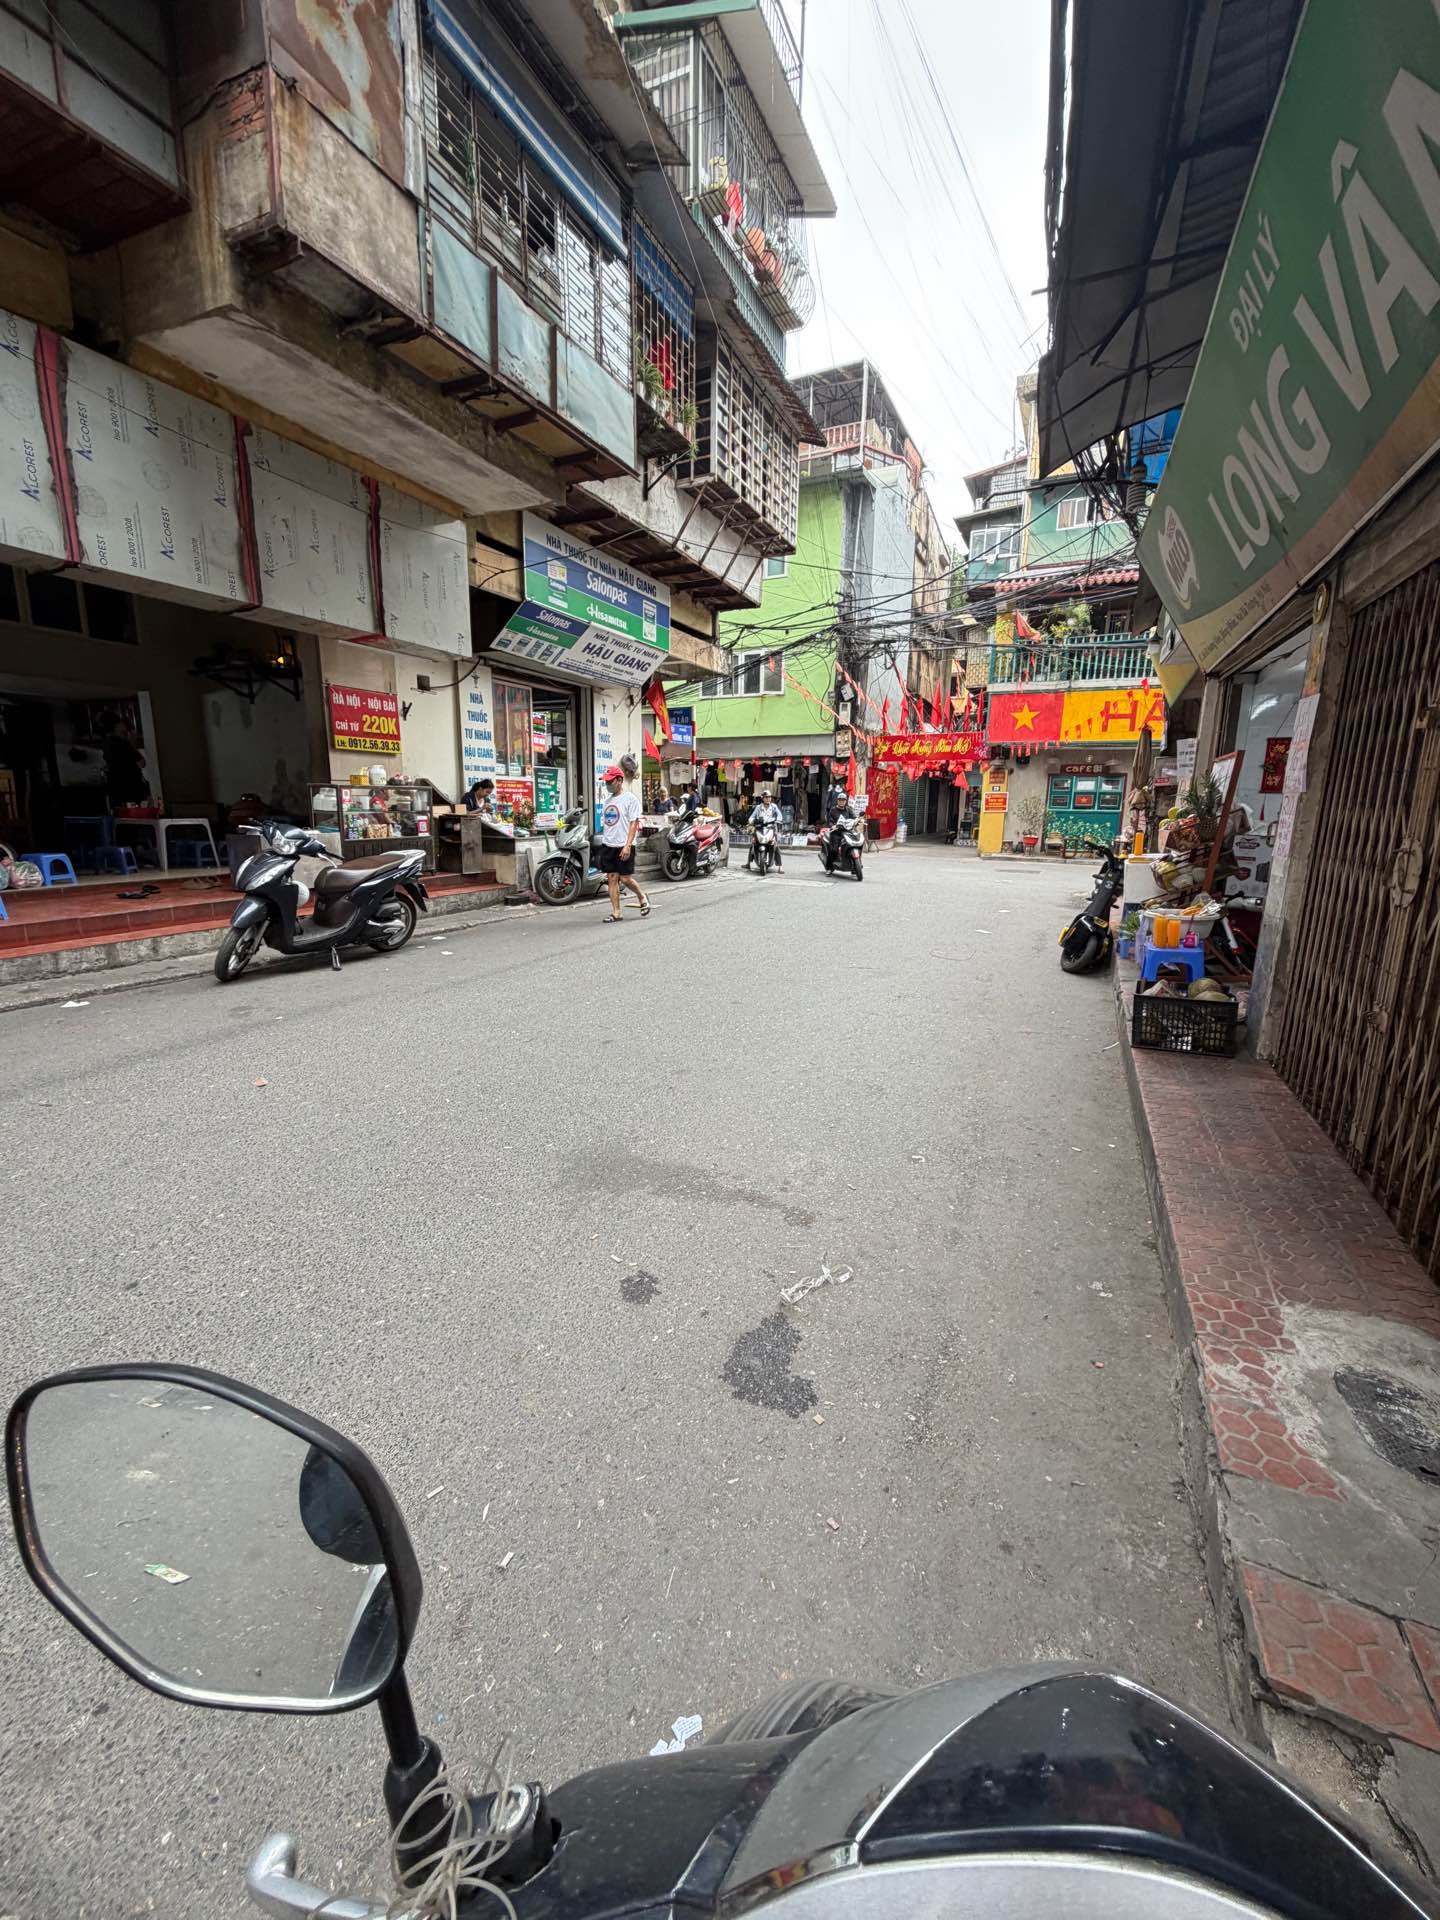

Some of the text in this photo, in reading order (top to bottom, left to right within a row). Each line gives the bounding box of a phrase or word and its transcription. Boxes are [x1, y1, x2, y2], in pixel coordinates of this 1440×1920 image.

[1229, 210, 1280, 353] ĐẠI LÝ
[74, 400, 93, 461] ALCOREST
[19, 438, 40, 502] ALCOREST
[1206, 343, 1331, 571] LONG
[160, 505, 175, 560] ALCOREST
[546, 533, 561, 551] NHÀ
[636, 578, 657, 598] GIANG
[586, 571, 628, 604] Salonpas
[536, 609, 572, 629] Salonpas
[586, 602, 627, 630] Hisamitsu
[594, 630, 610, 642] NHÀ
[582, 640, 651, 673] HẬU GIANG
[469, 692, 484, 704] NHÀ
[362, 714, 398, 735] 220K
[467, 709, 488, 723] THUỐC
[348, 738, 400, 751] 0912.56.39.33
